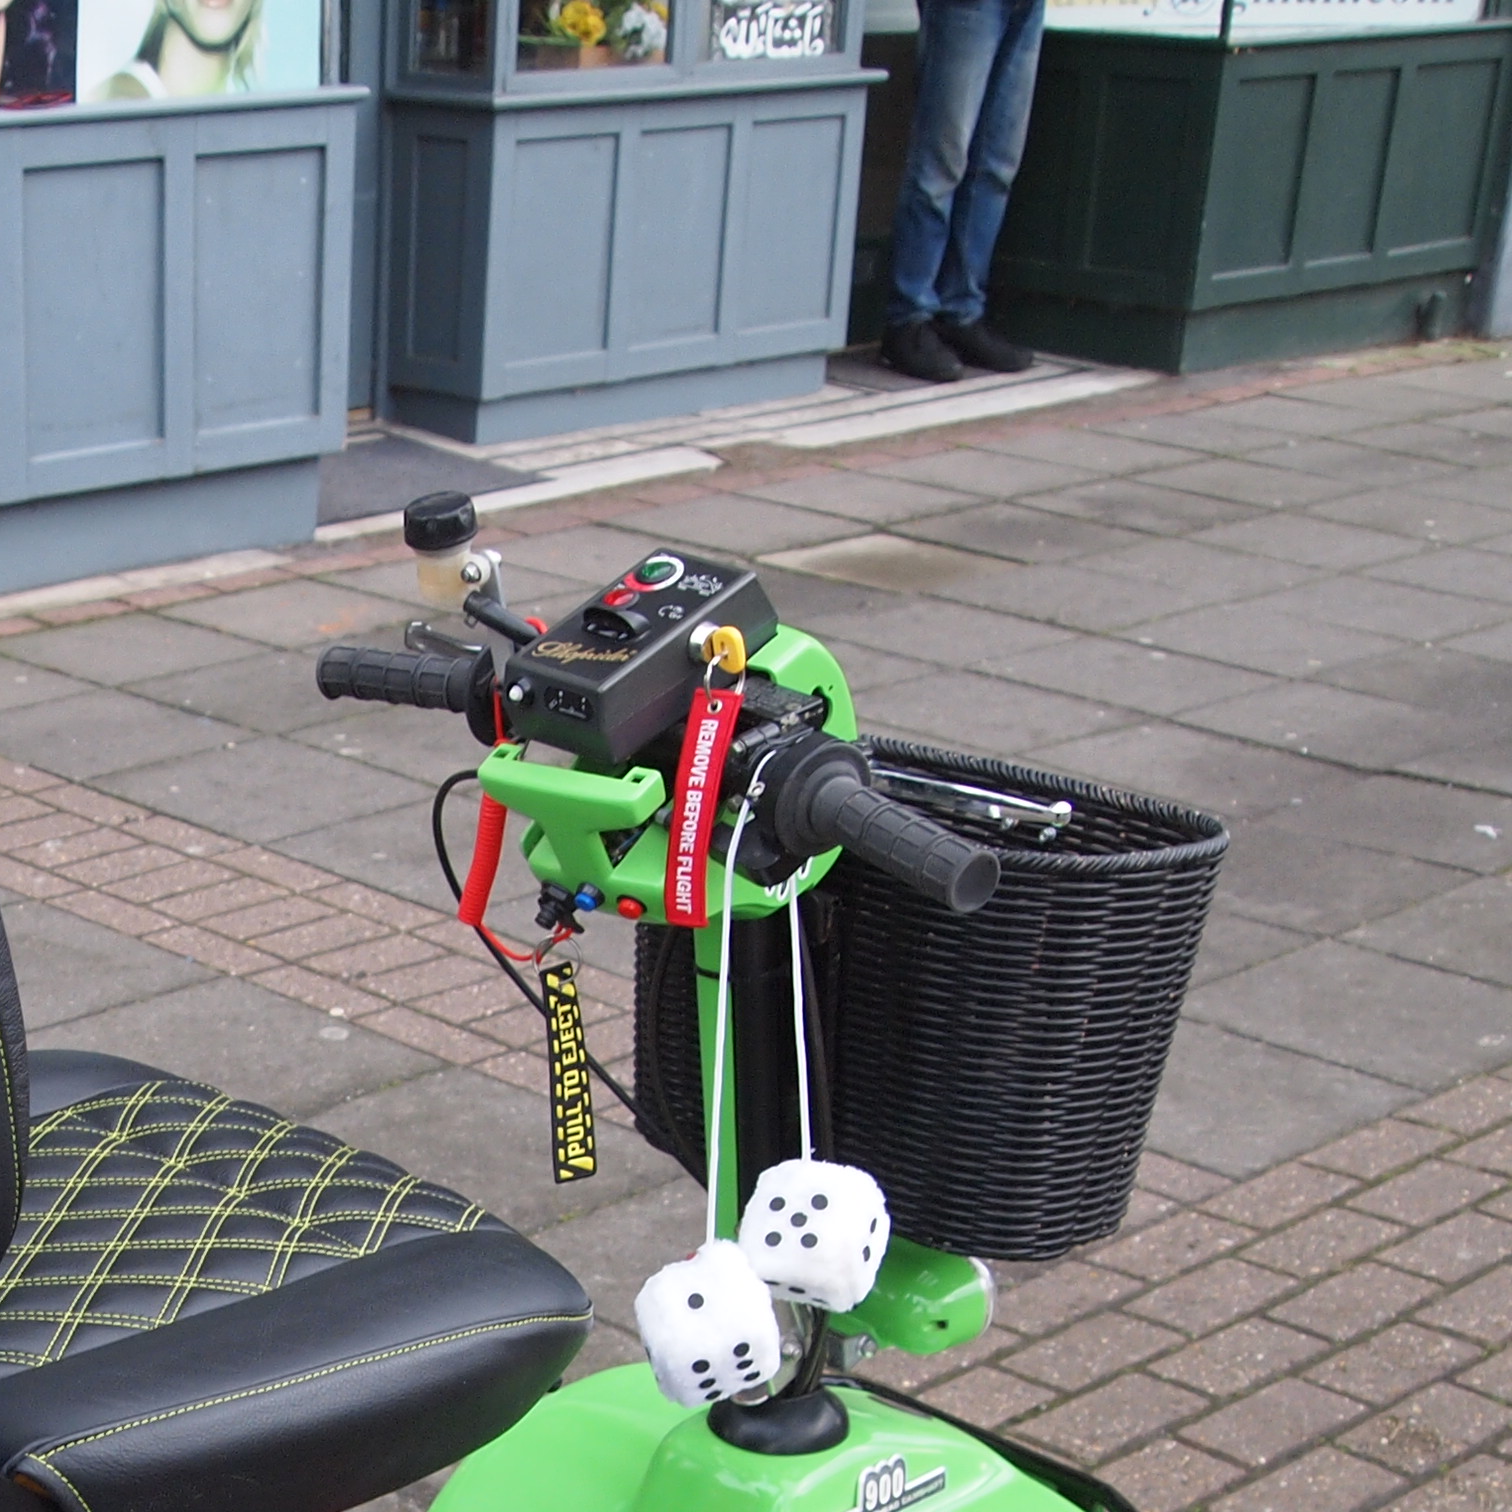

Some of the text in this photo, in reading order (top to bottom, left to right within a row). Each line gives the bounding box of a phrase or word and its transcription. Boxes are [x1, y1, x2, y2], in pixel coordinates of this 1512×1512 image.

[674, 718, 719, 915] REMOVE BEFORE FLIGHT
[556, 1002, 586, 1158] PULL TO EJECT
[865, 1465, 904, 1511] 900
